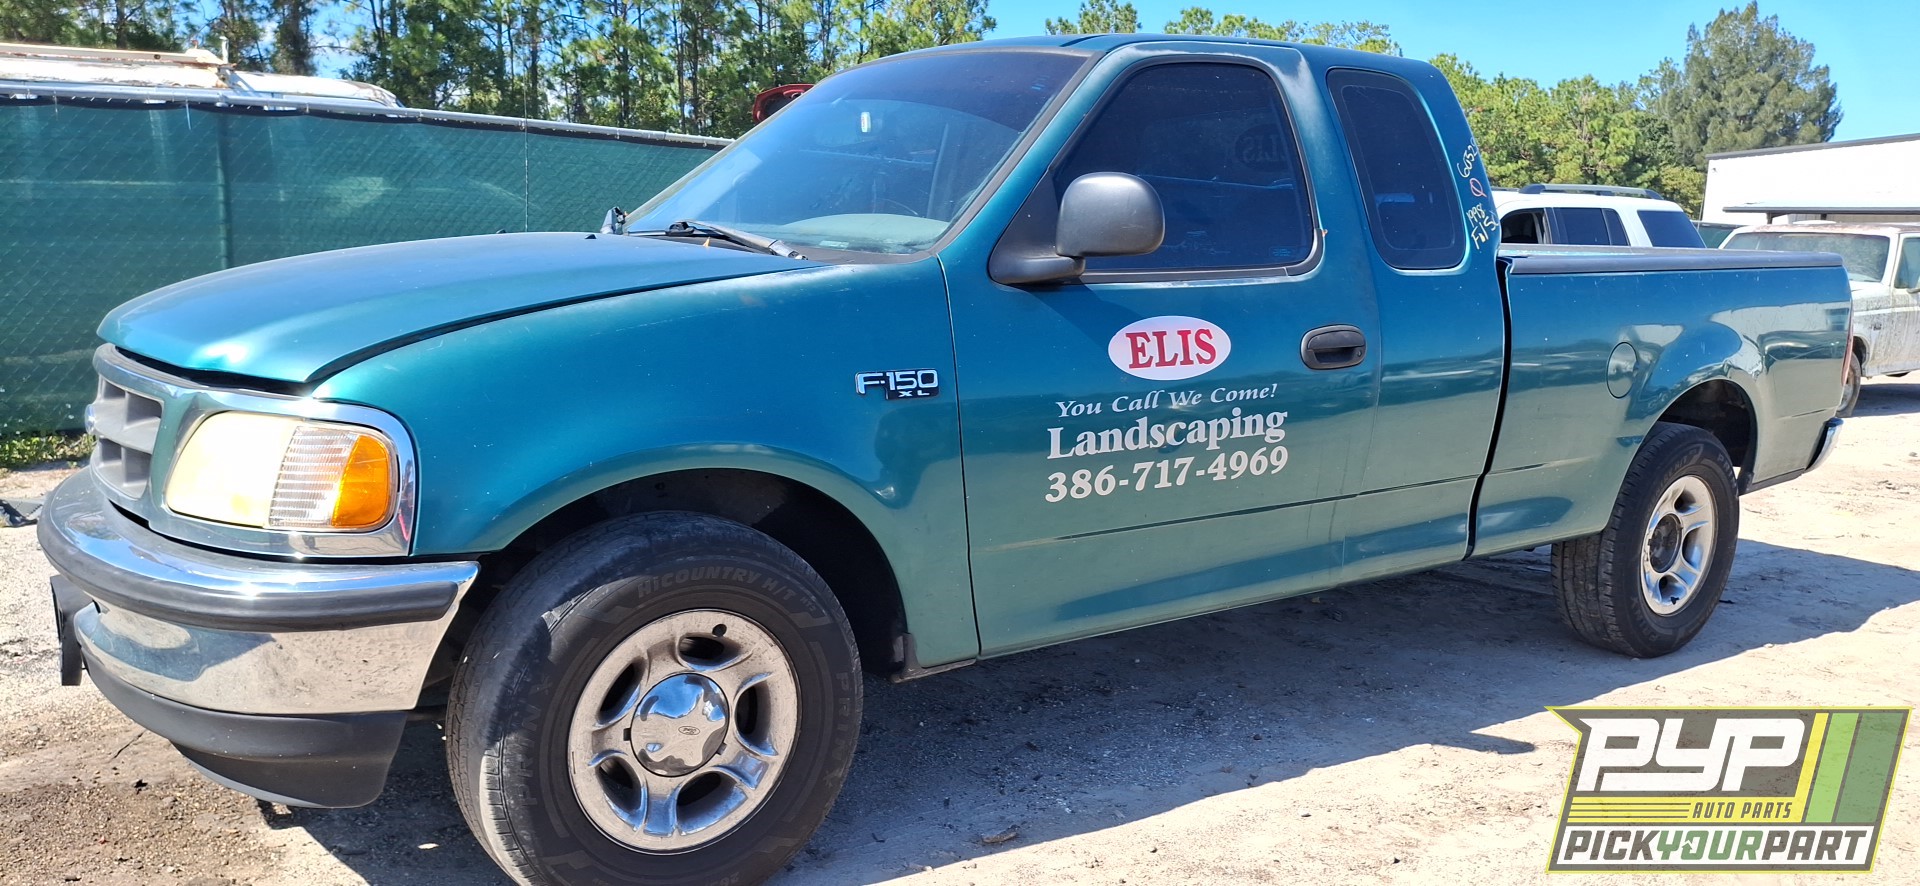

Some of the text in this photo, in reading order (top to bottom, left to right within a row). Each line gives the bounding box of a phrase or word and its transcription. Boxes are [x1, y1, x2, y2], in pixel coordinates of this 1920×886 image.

[1125, 328, 1217, 369] ELIS
[855, 369, 939, 394] F-150
[898, 390, 930, 398] XL
[1055, 383, 1278, 418] You Call We Come!
[1047, 407, 1288, 459] Landscaping
[1045, 446, 1289, 503] 386-717-4969
